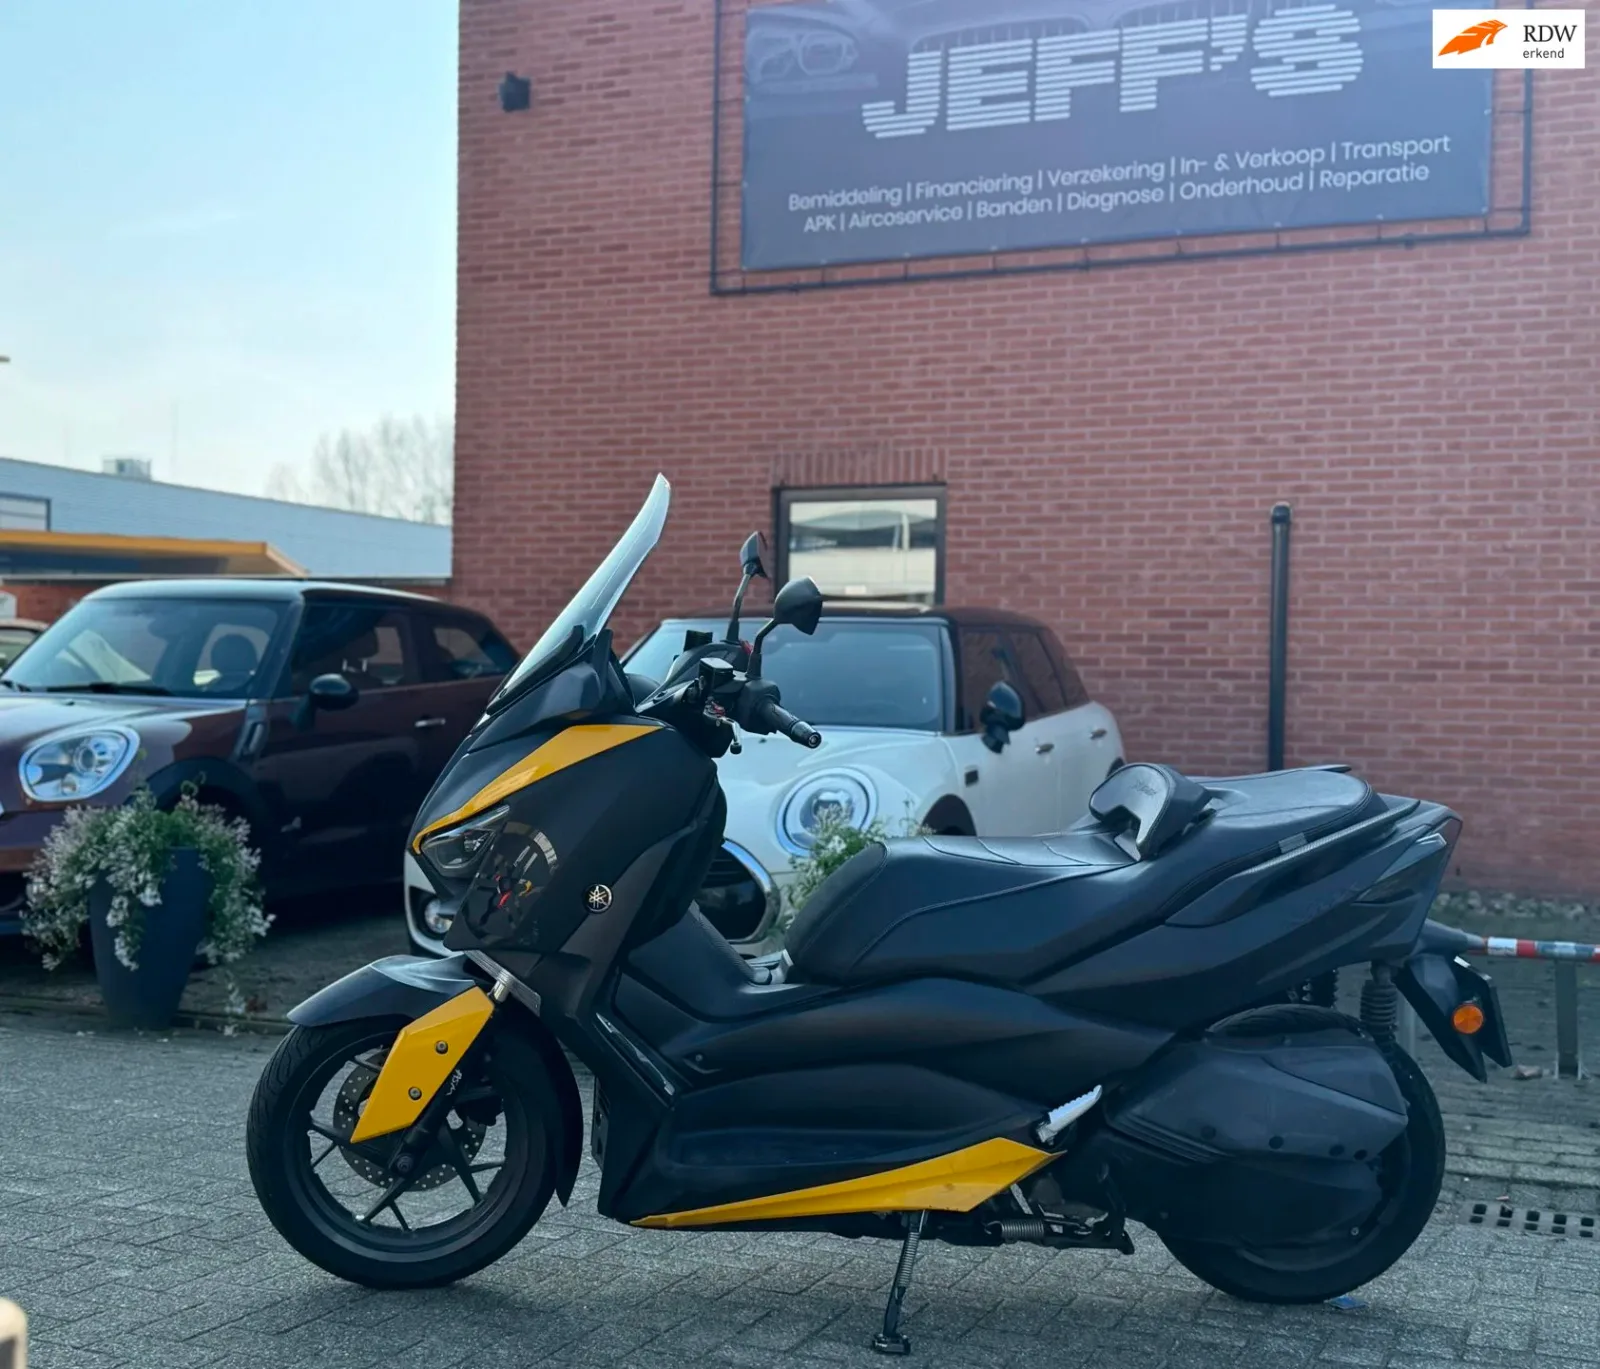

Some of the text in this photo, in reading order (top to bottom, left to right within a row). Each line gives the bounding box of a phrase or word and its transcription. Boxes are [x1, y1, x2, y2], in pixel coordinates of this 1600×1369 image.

[862, 4, 1364, 139] JEFF'S
[788, 185, 901, 211] Bemiddeling
[916, 173, 1032, 200] Financiering
[1047, 160, 1165, 187] Verzekering
[1181, 156, 1207, 175] In-
[1214, 153, 1230, 171] &
[1235, 147, 1324, 170] Verkoop
[1341, 135, 1451, 160] Transport
[804, 213, 836, 232] APK
[849, 204, 962, 229] Aircoservice
[977, 195, 1052, 218] Banden
[1067, 187, 1163, 213] Diagnose
[1180, 172, 1303, 200] Onderhoud
[1320, 162, 1430, 191] Reparatie
